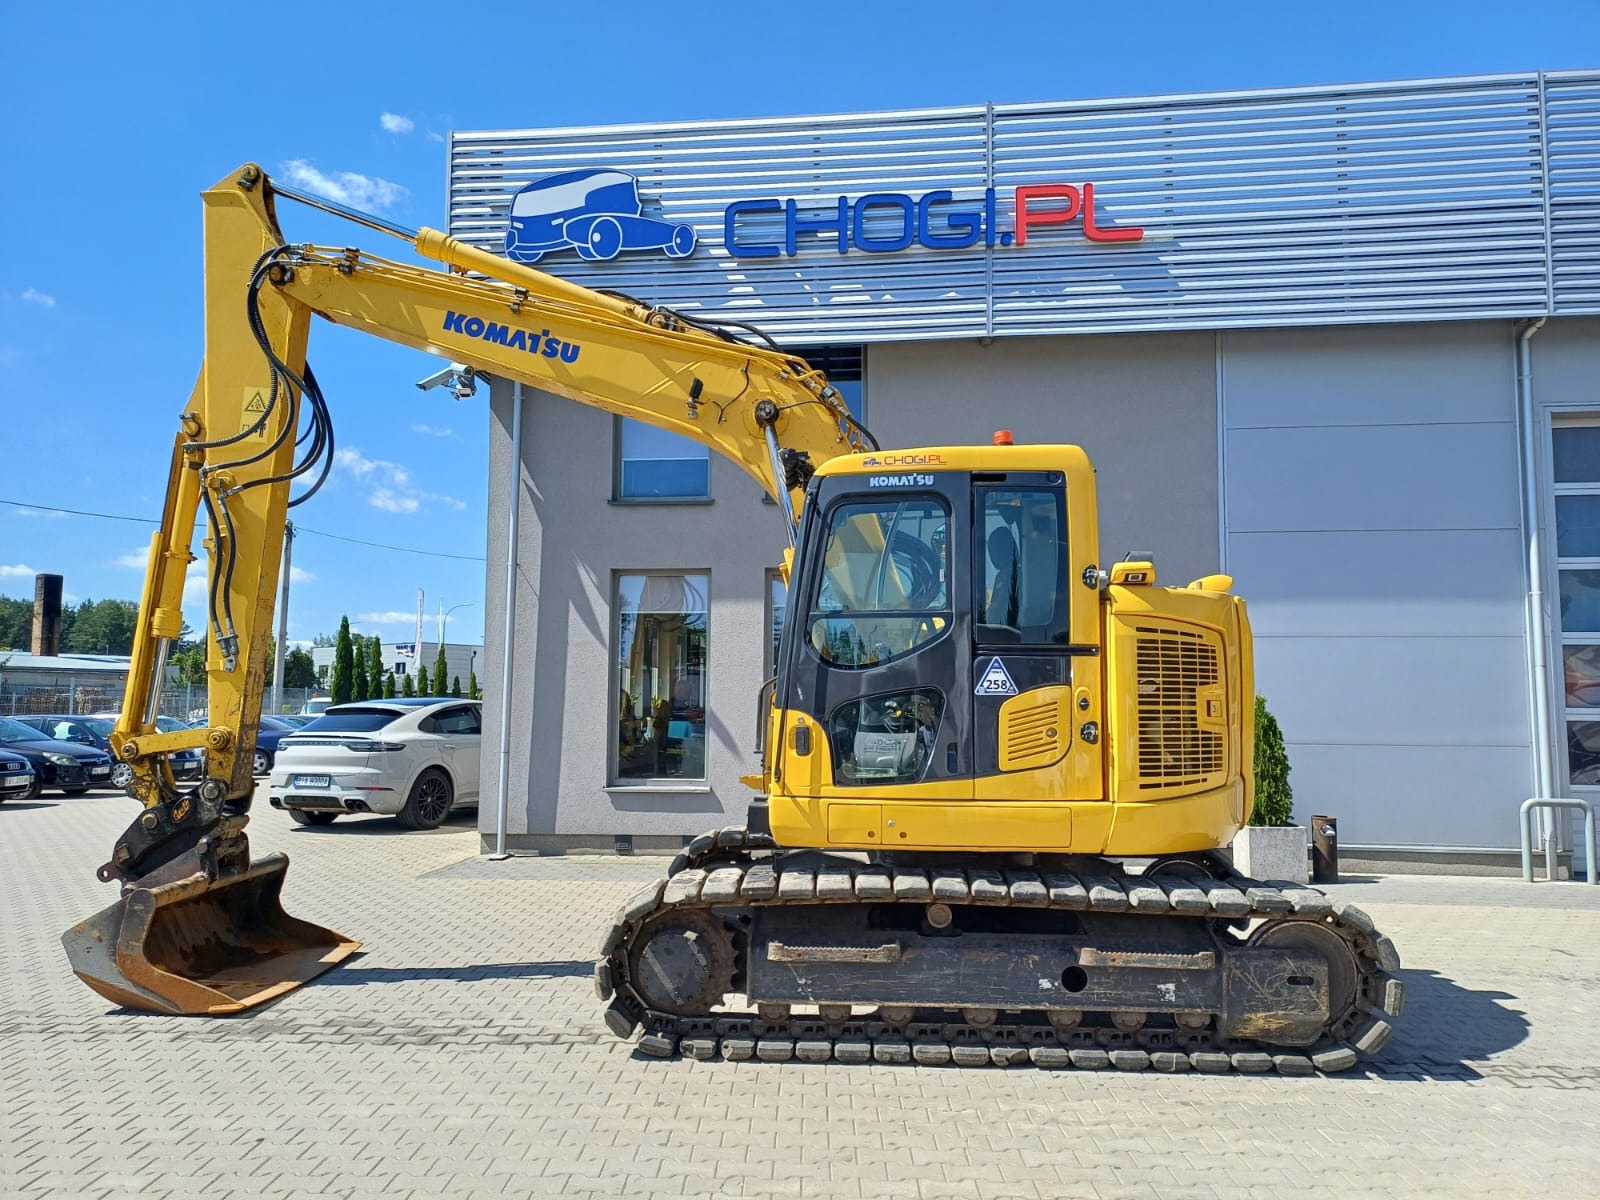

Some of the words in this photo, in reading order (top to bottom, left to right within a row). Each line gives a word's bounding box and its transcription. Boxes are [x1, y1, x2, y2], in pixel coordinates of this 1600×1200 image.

[724, 183, 1144, 258] CHOGI.PL
[442, 310, 581, 363] KOMATSU
[884, 455, 948, 465] CHOGI.PL
[869, 473, 934, 487] KOMATSU
[986, 680, 1007, 690] 258
